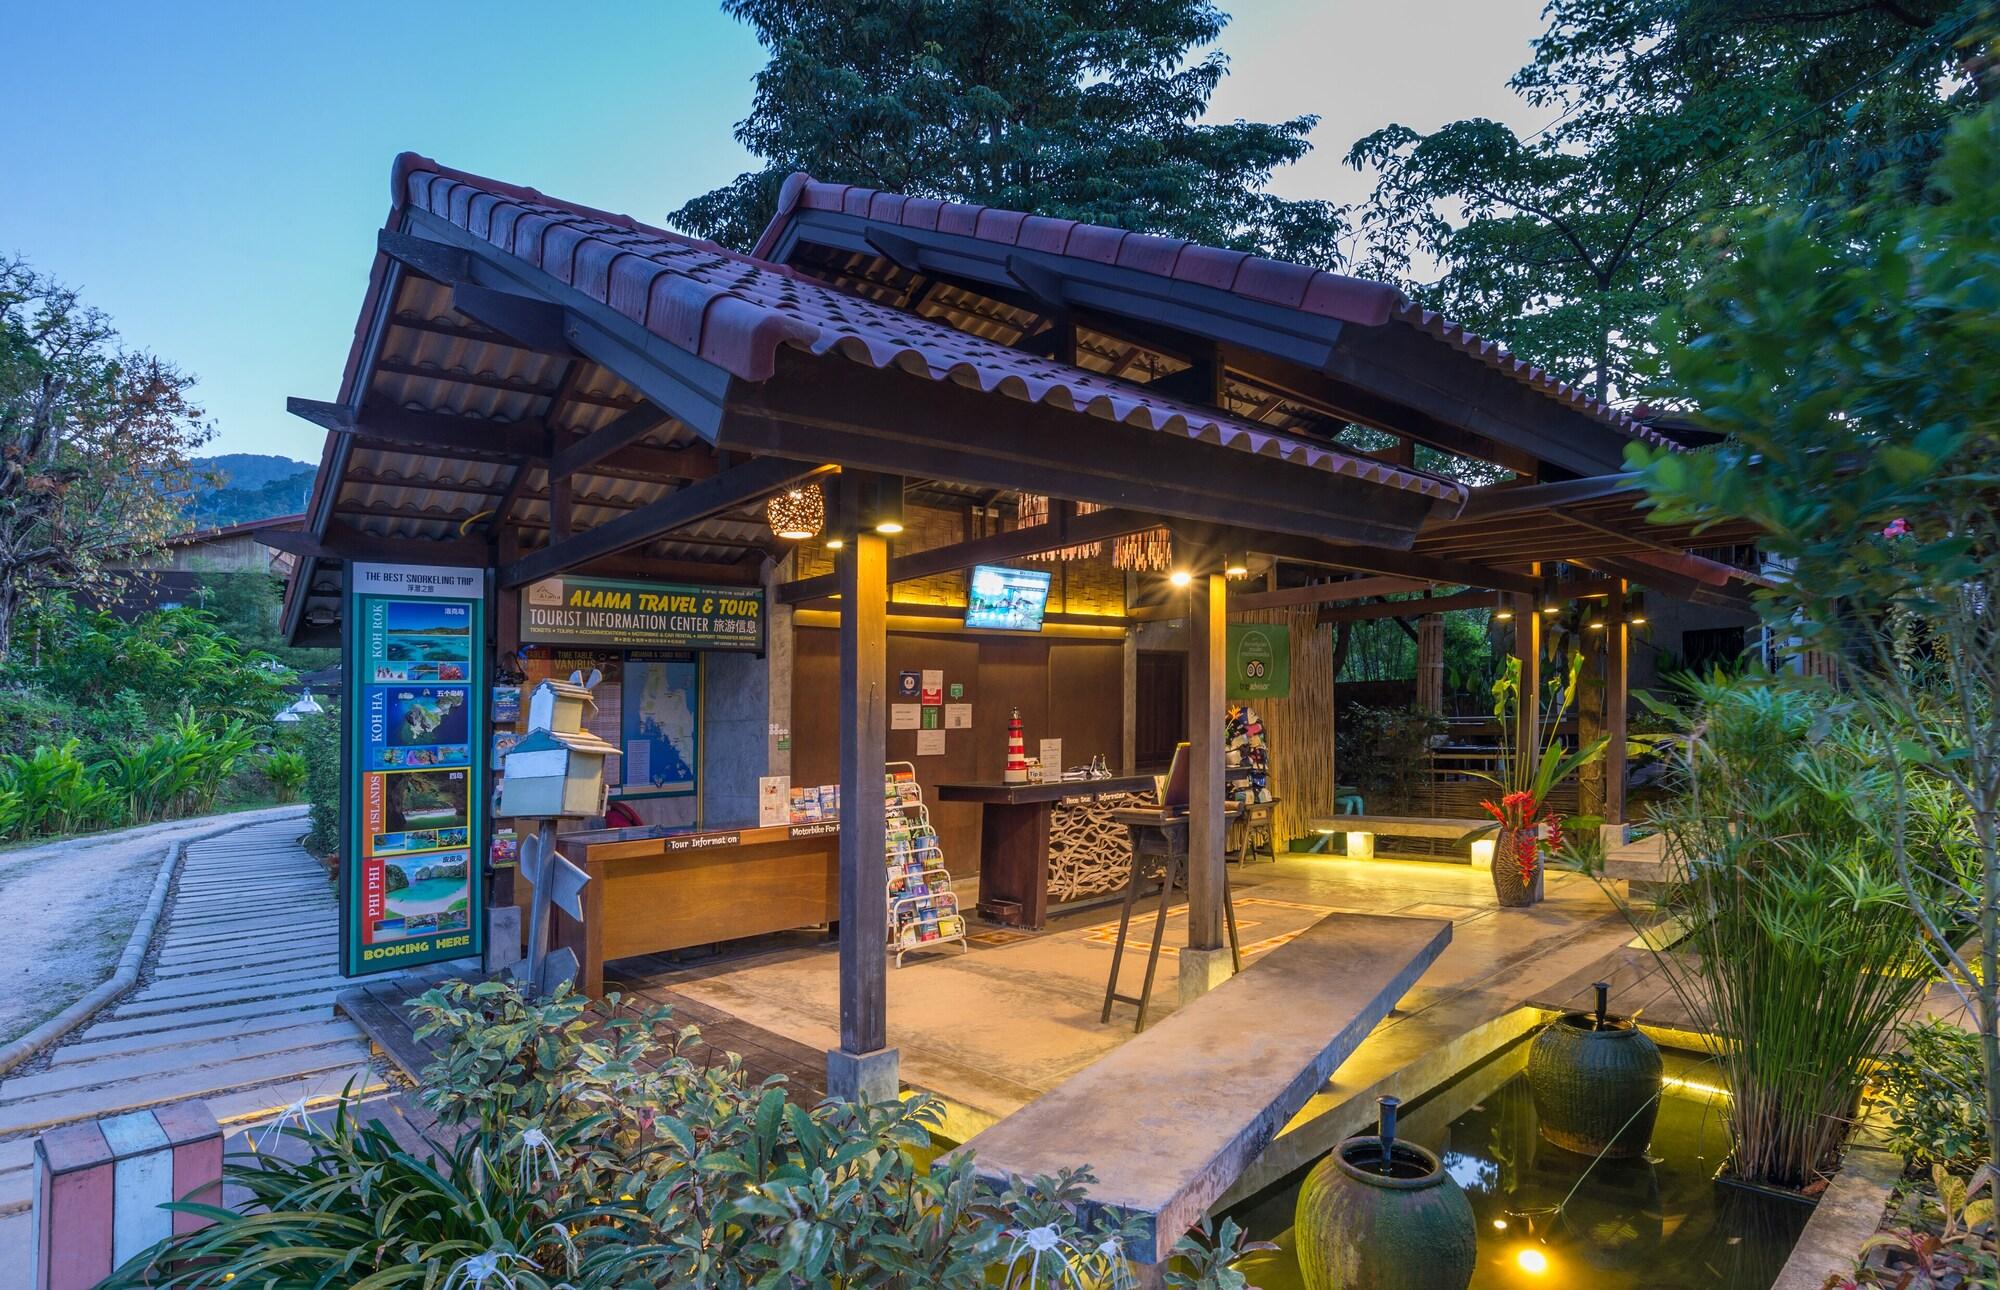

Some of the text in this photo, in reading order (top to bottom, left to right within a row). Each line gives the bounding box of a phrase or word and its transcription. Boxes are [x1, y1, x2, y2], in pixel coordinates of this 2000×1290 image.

[365, 571, 474, 586] THE BEST SNORKELING TRIP
[569, 589, 759, 618] ALAMA TRAVEL & TOUR
[372, 604, 383, 658] KOH ROK
[529, 609, 709, 632] TOURIST INFORMATION CENTER
[713, 618, 757, 634] 旅游信息
[558, 650, 593, 659] TIME TABLE
[372, 692, 383, 742] KOH HA
[370, 776, 380, 824] ISLANDS
[670, 836, 737, 849] Tour Informaton
[792, 825, 825, 836] Motorbike
[368, 866, 380, 917] PHI PHI
[364, 935, 470, 961] BOOKING HERE
